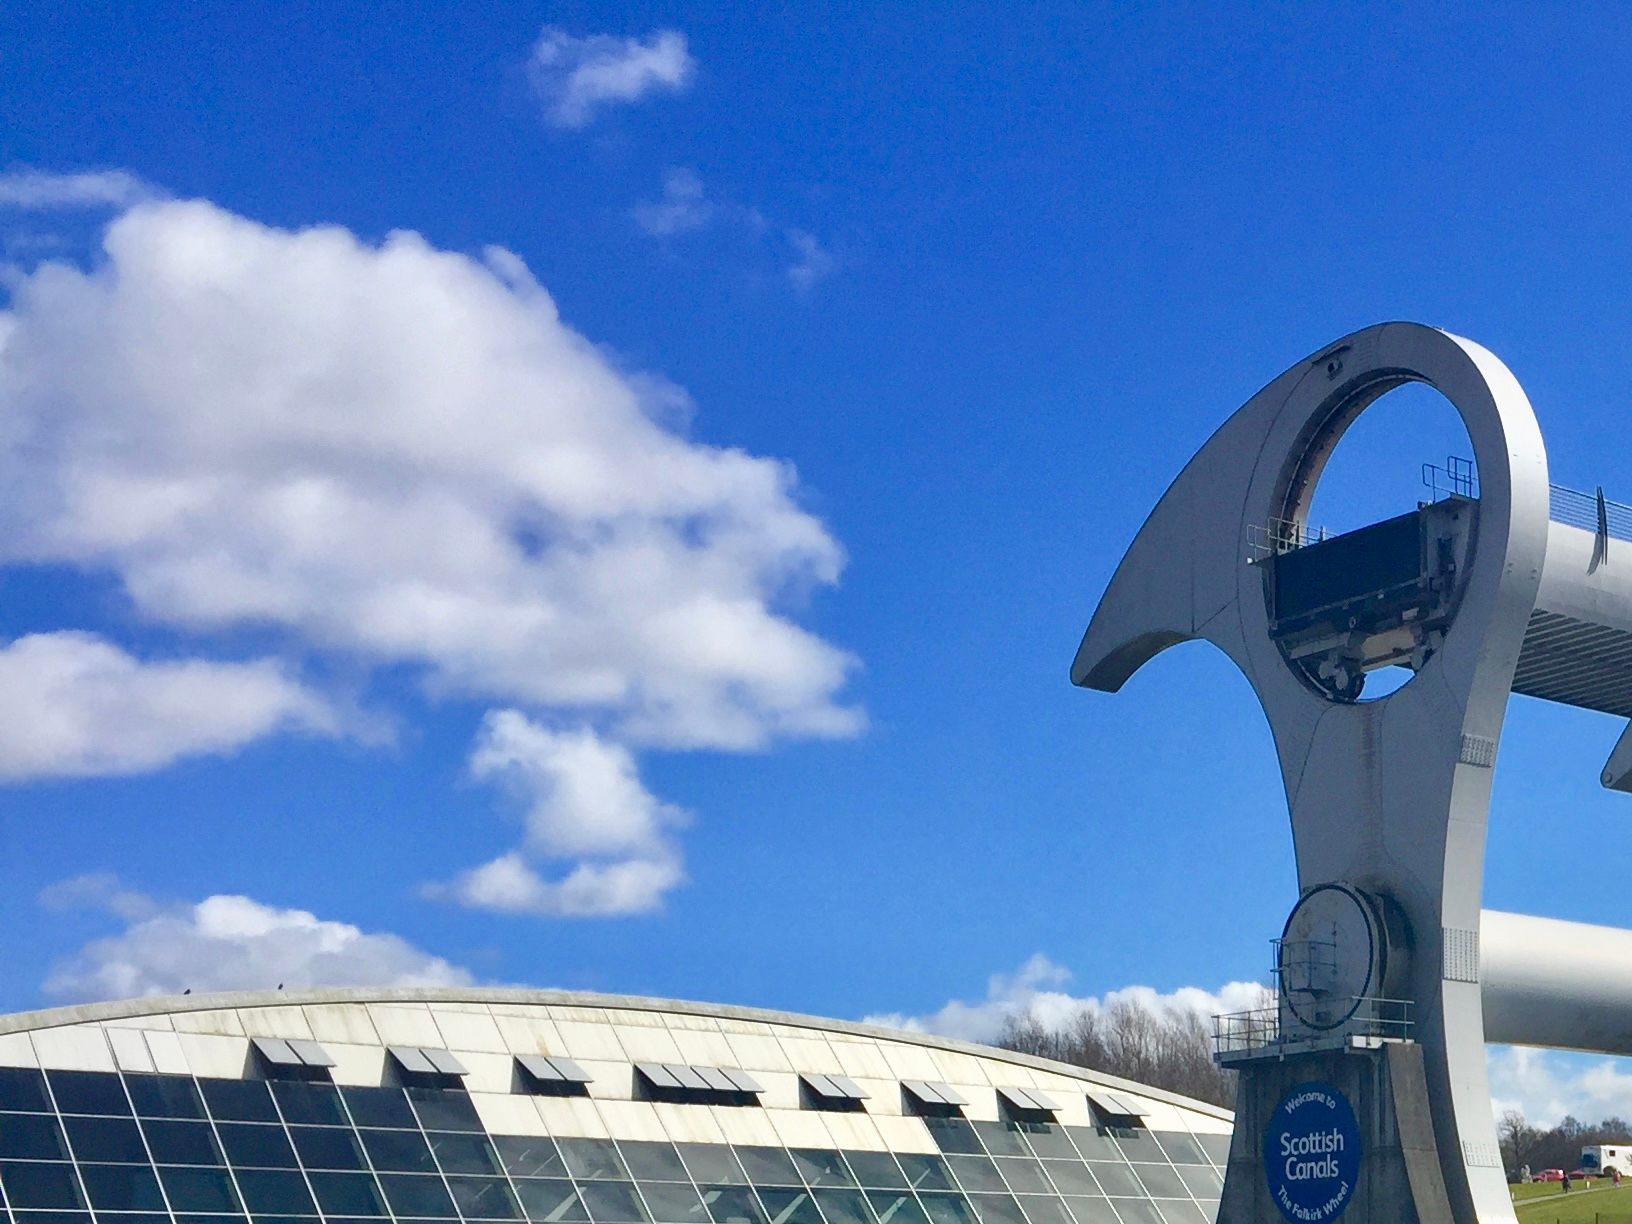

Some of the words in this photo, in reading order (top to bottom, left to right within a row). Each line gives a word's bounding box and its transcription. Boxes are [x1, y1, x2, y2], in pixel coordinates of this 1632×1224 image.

[1285, 1092, 1325, 1114] Welcome
[1326, 1095, 1336, 1109] to
[1280, 1128, 1344, 1156] Scottish
[1285, 1154, 1339, 1180] Canals
[1278, 1185, 1292, 1210] The
[1292, 1203, 1322, 1221] Falkirk
[1323, 1181, 1349, 1215] Wheel
